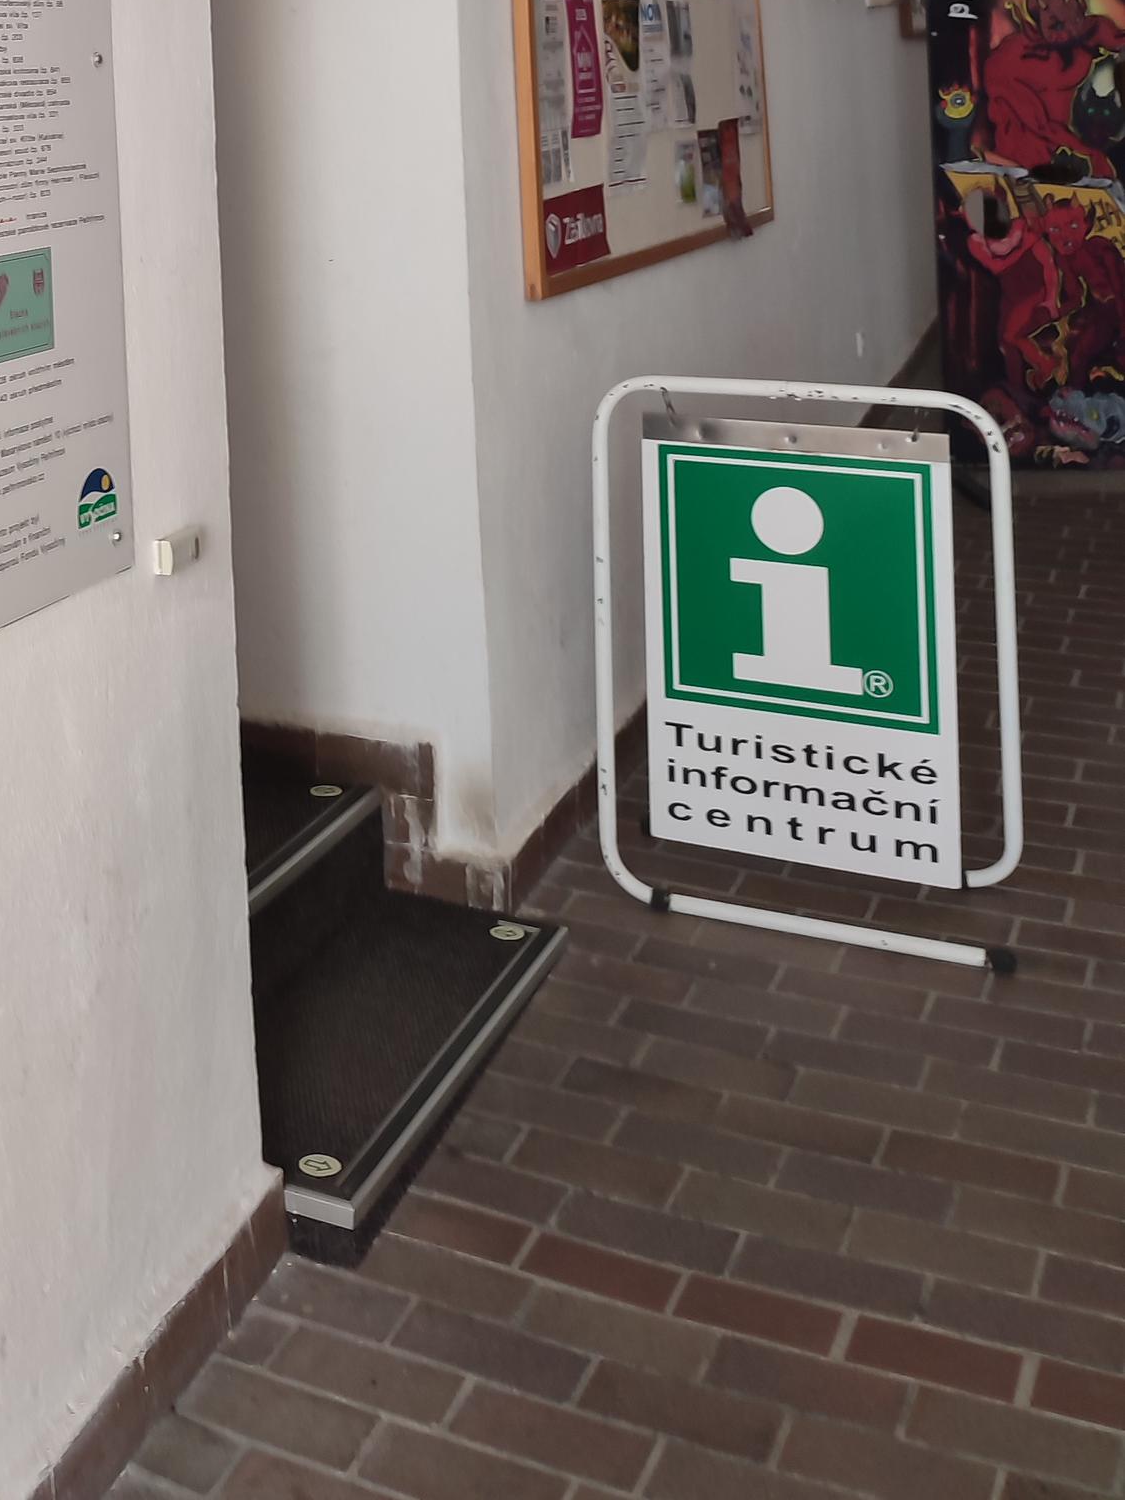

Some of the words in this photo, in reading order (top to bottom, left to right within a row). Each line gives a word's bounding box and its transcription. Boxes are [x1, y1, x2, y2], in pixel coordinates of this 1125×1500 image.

[665, 721, 938, 785] Turistické
[667, 758, 939, 825] informační
[667, 801, 939, 864] centrum
